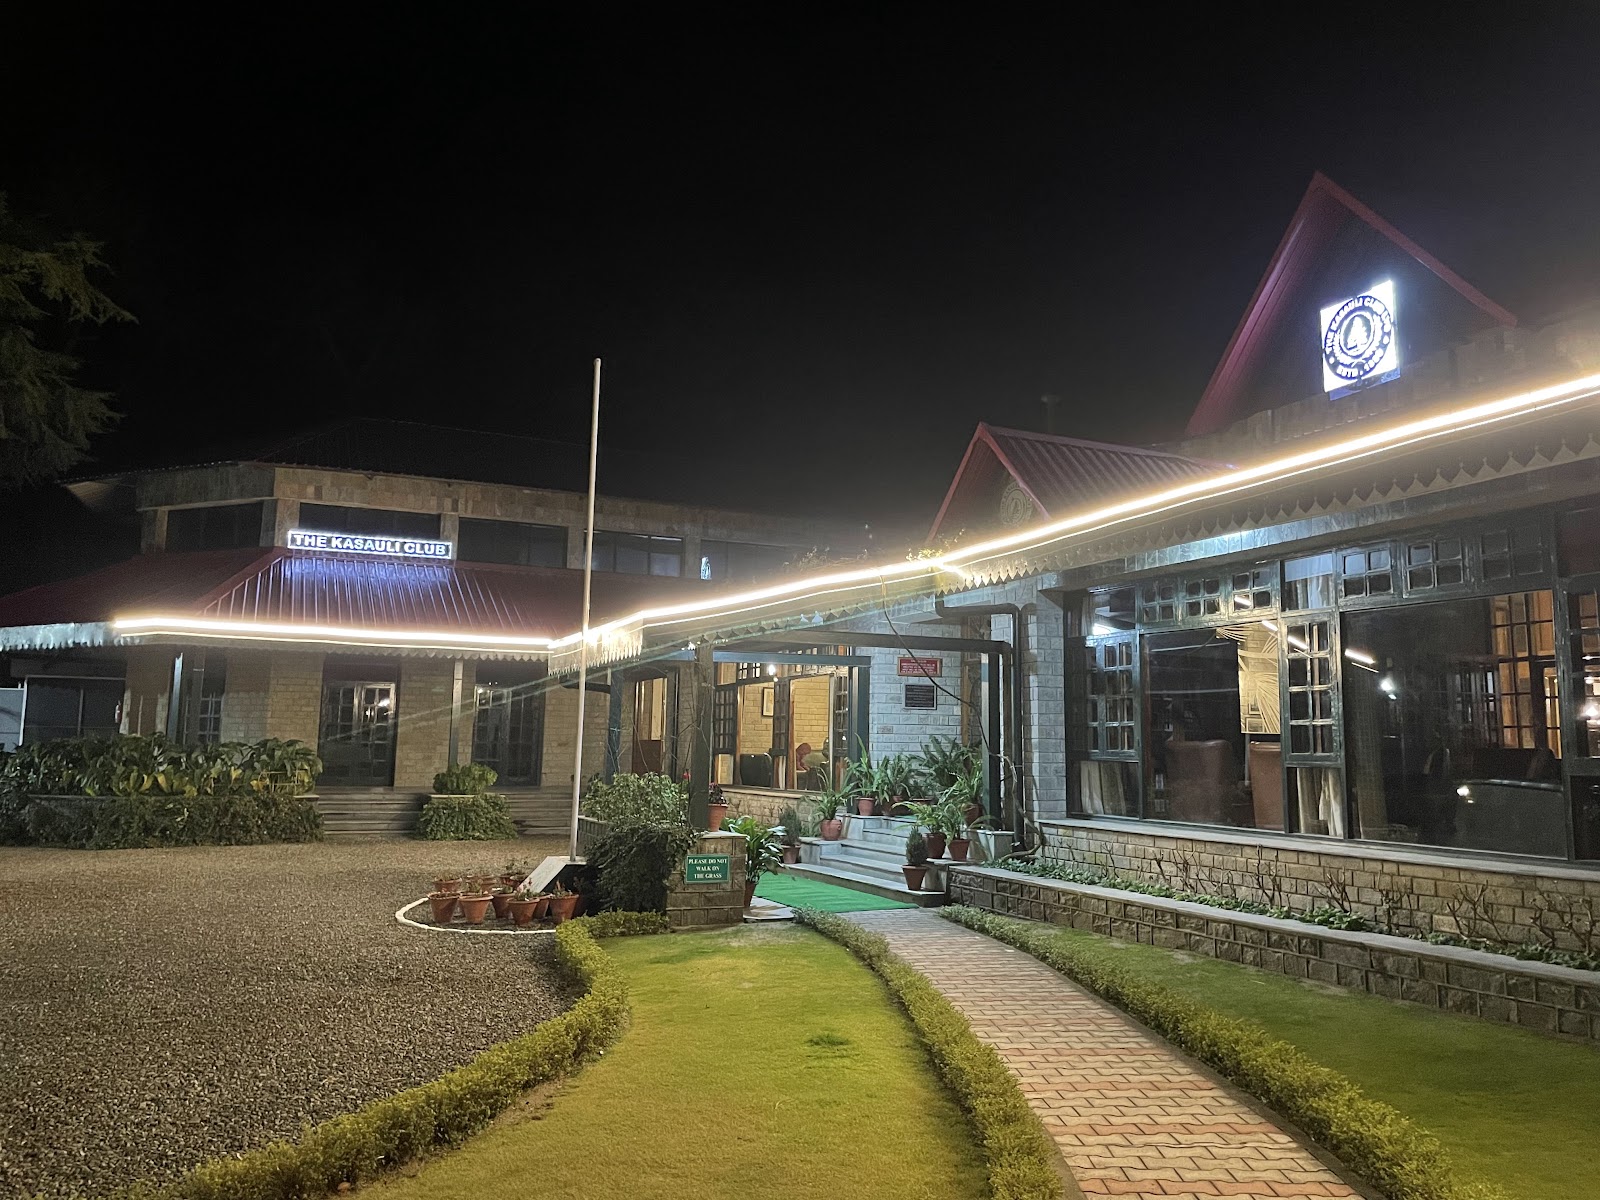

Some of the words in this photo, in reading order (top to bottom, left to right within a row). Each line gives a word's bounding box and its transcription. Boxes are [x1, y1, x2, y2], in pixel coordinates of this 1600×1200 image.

[294, 534, 327, 548] THE
[331, 537, 400, 553] KASAULI
[403, 542, 446, 555] CLUB
